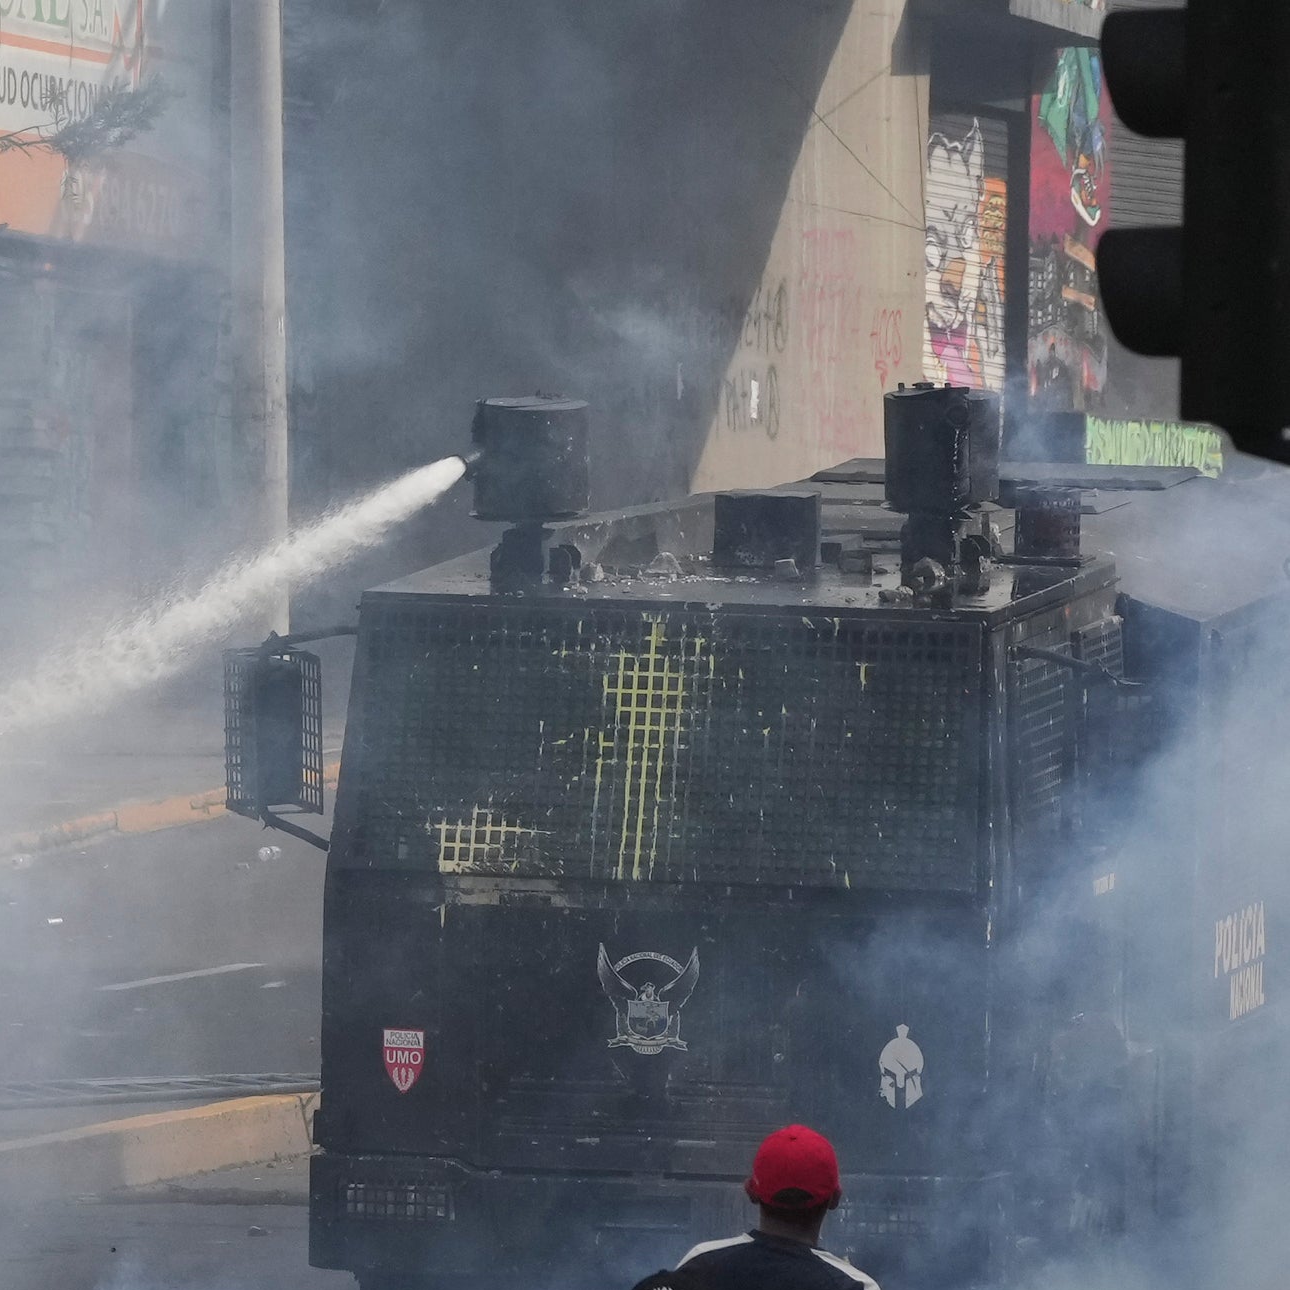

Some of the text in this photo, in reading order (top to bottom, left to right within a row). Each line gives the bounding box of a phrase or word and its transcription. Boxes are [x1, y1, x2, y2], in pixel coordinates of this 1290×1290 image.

[20, 69, 102, 122] OCUPACION
[1214, 900, 1265, 979] POLICIA
[386, 1050, 421, 1065] UMO
